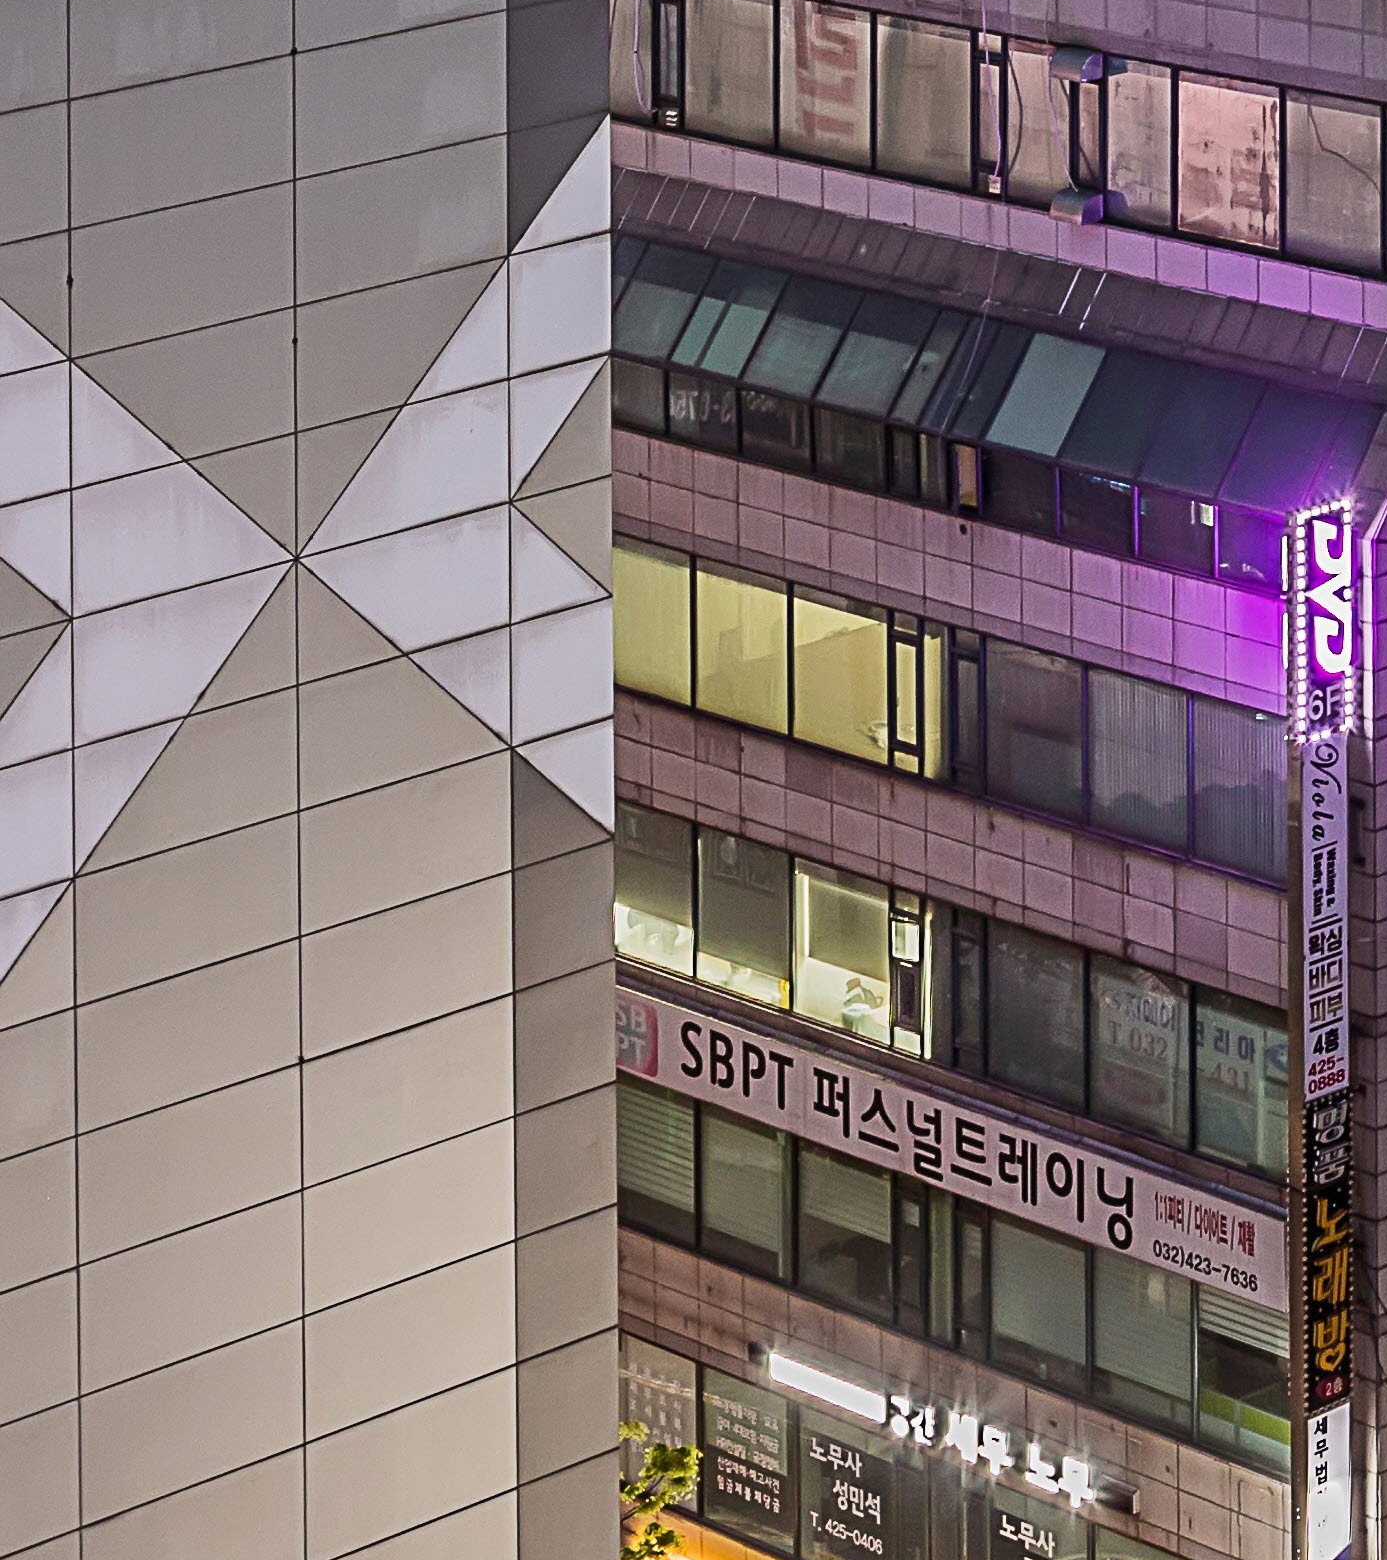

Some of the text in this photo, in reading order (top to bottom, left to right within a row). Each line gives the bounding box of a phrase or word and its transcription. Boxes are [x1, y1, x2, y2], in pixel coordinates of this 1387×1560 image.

[1308, 685, 1342, 722] 6F
[1309, 928, 1342, 956] 왁싱
[1309, 963, 1343, 991] 바디
[1309, 995, 1343, 1023] 피부
[1313, 1028, 1340, 1056] 4층
[1308, 1054, 1344, 1077] 425-
[1308, 1069, 1345, 1095] 0888
[680, 1021, 1134, 1250] SBPT 퍼스널트레이닝
[1153, 1239, 1258, 1292] 032)423-7636
[1311, 1196, 1349, 1372] 노래방
[810, 1437, 862, 1477] 노무사
[1025, 1442, 1095, 1508] 노무
[832, 1481, 882, 1523] 성민석
[825, 1517, 883, 1554] 425-0406
[1000, 1515, 1055, 1557] 노무사
